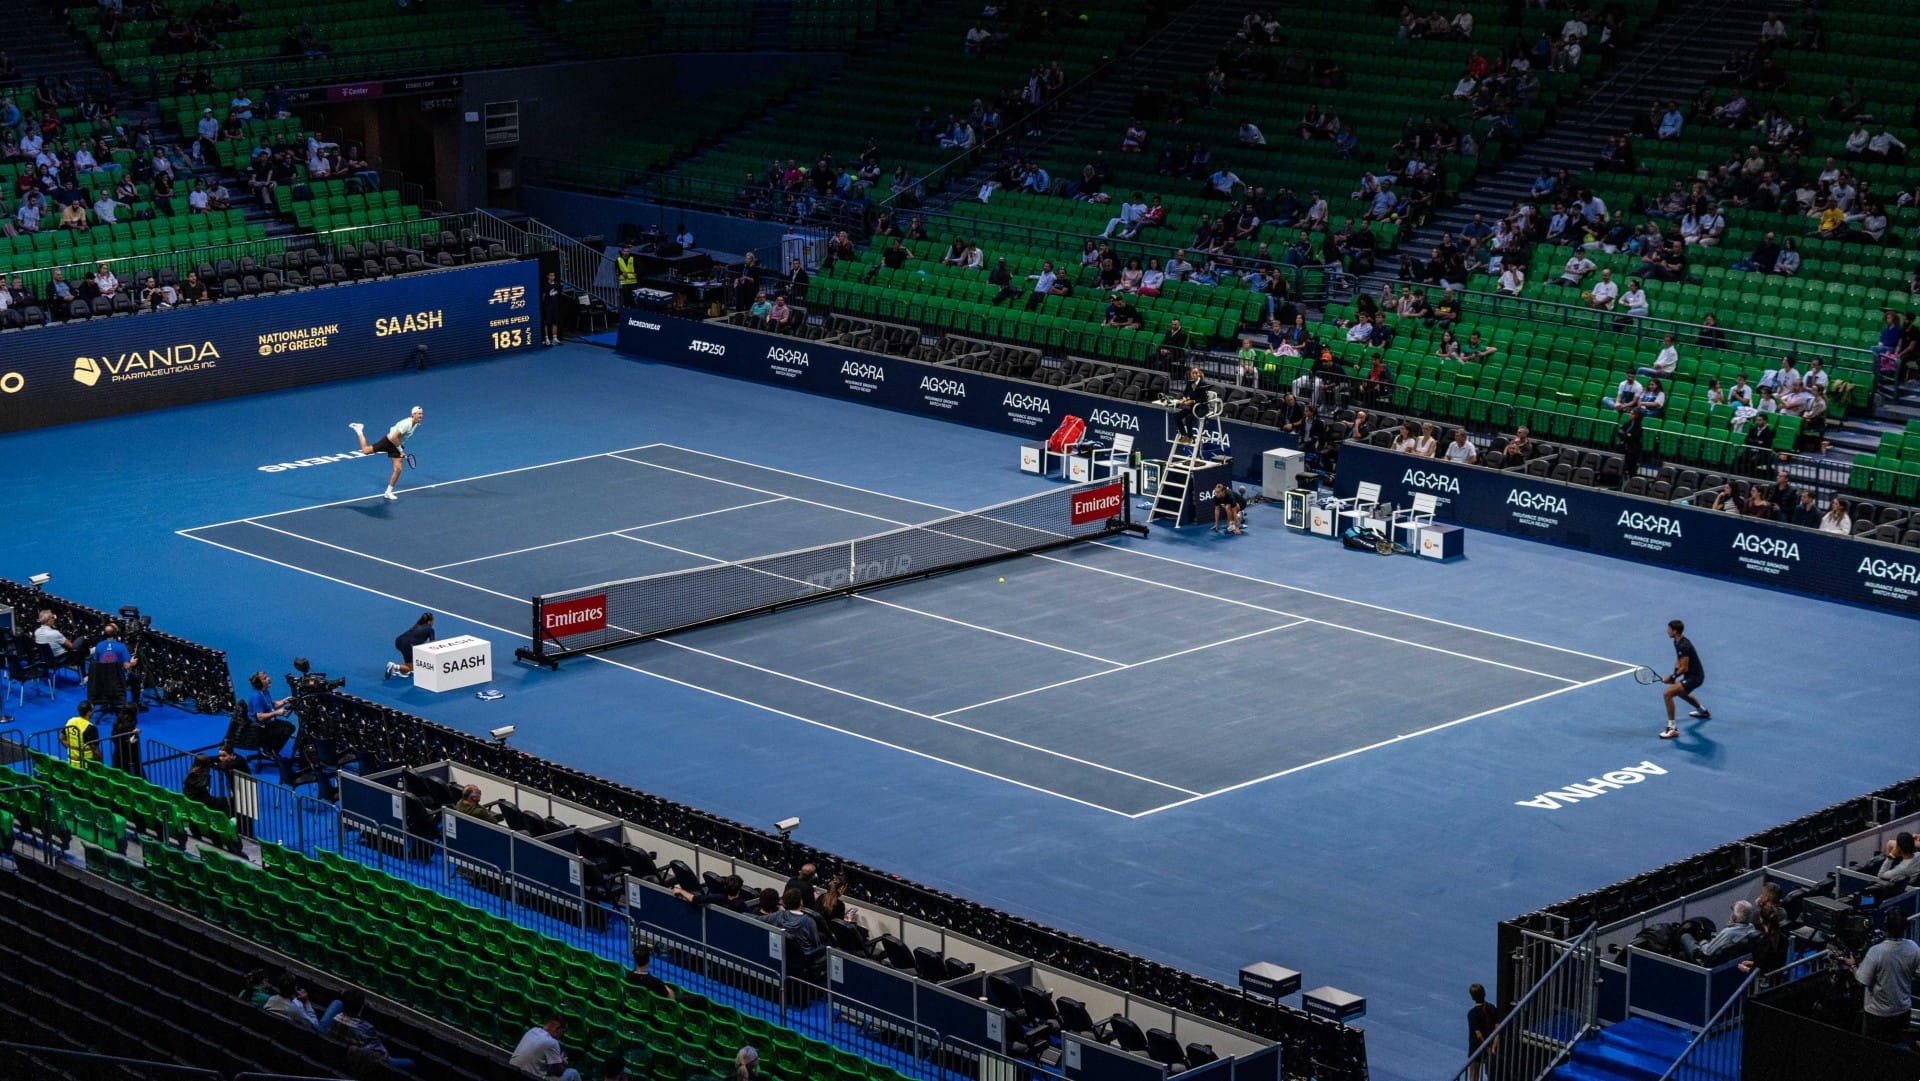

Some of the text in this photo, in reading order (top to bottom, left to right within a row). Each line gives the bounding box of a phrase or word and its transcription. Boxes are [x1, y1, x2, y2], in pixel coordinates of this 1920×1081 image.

[488, 286, 525, 304] ATP
[510, 300, 526, 310] 250
[375, 310, 442, 337] SAASH
[510, 315, 530, 324] SPEED
[258, 324, 339, 344] NATIONAL BANK
[274, 336, 328, 353] OF GREECE
[492, 329, 522, 350] 183
[102, 341, 220, 374] VANDA
[767, 346, 808, 366] AGORA
[112, 363, 199, 382] PHARMACEUTICALS
[841, 360, 884, 382] AGORA
[920, 376, 966, 397] AGORA
[1002, 392, 1050, 414] AGORA
[1089, 408, 1140, 431] AGORA
[1402, 468, 1460, 494] AGORA
[1074, 494, 1120, 515] Emirates
[1506, 489, 1568, 515] AGORA
[1617, 510, 1682, 537] AGORA
[1732, 532, 1800, 560] AGORA
[546, 607, 603, 628] Emirates
[415, 659, 435, 671] SAASH
[442, 654, 485, 674] SAASH
